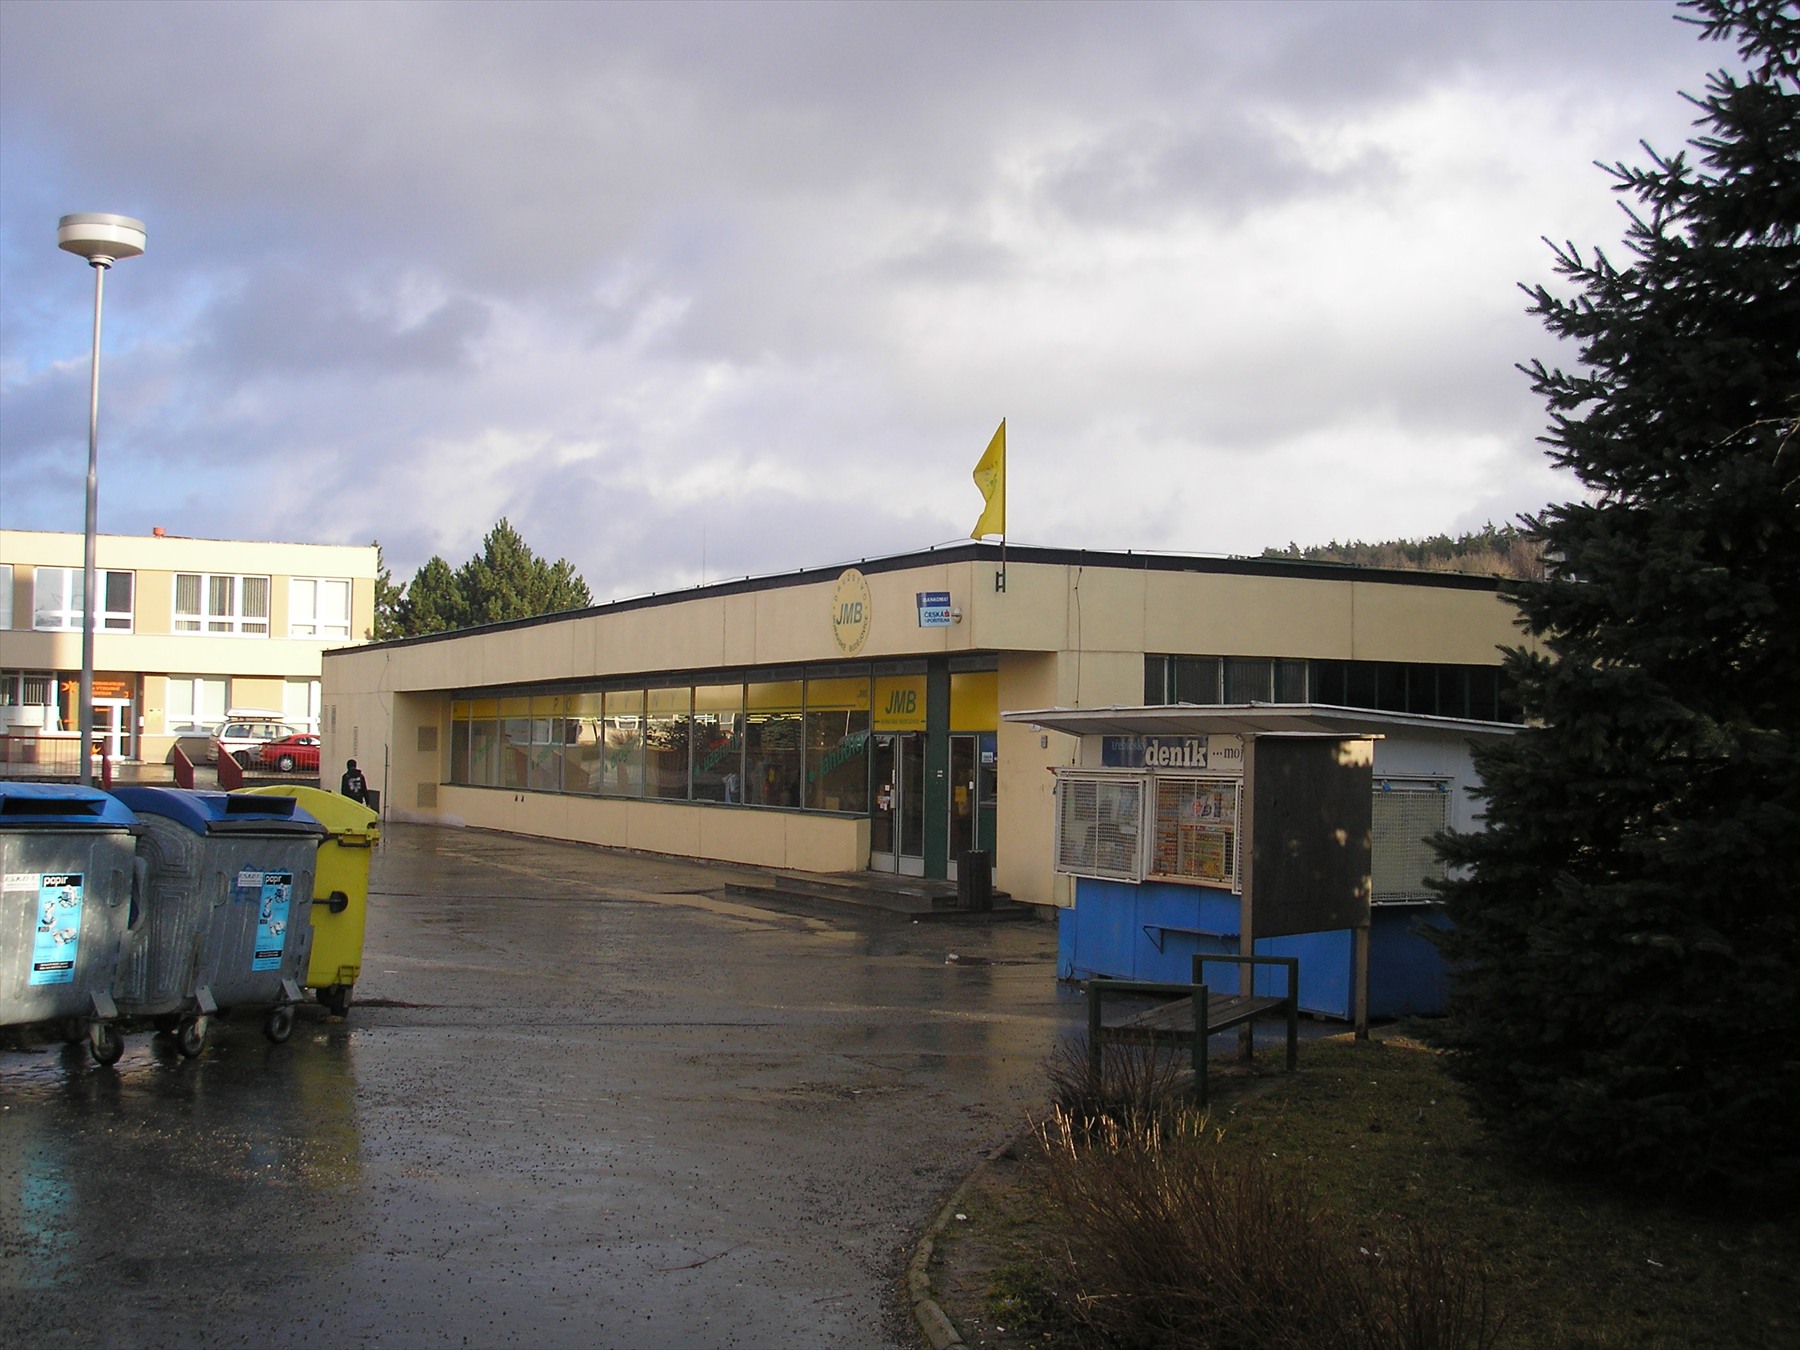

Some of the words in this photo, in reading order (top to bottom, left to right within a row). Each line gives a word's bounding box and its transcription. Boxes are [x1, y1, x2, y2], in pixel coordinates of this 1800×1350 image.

[836, 602, 863, 625] JMB
[885, 690, 917, 714] JMB
[1145, 740, 1207, 767] deník
